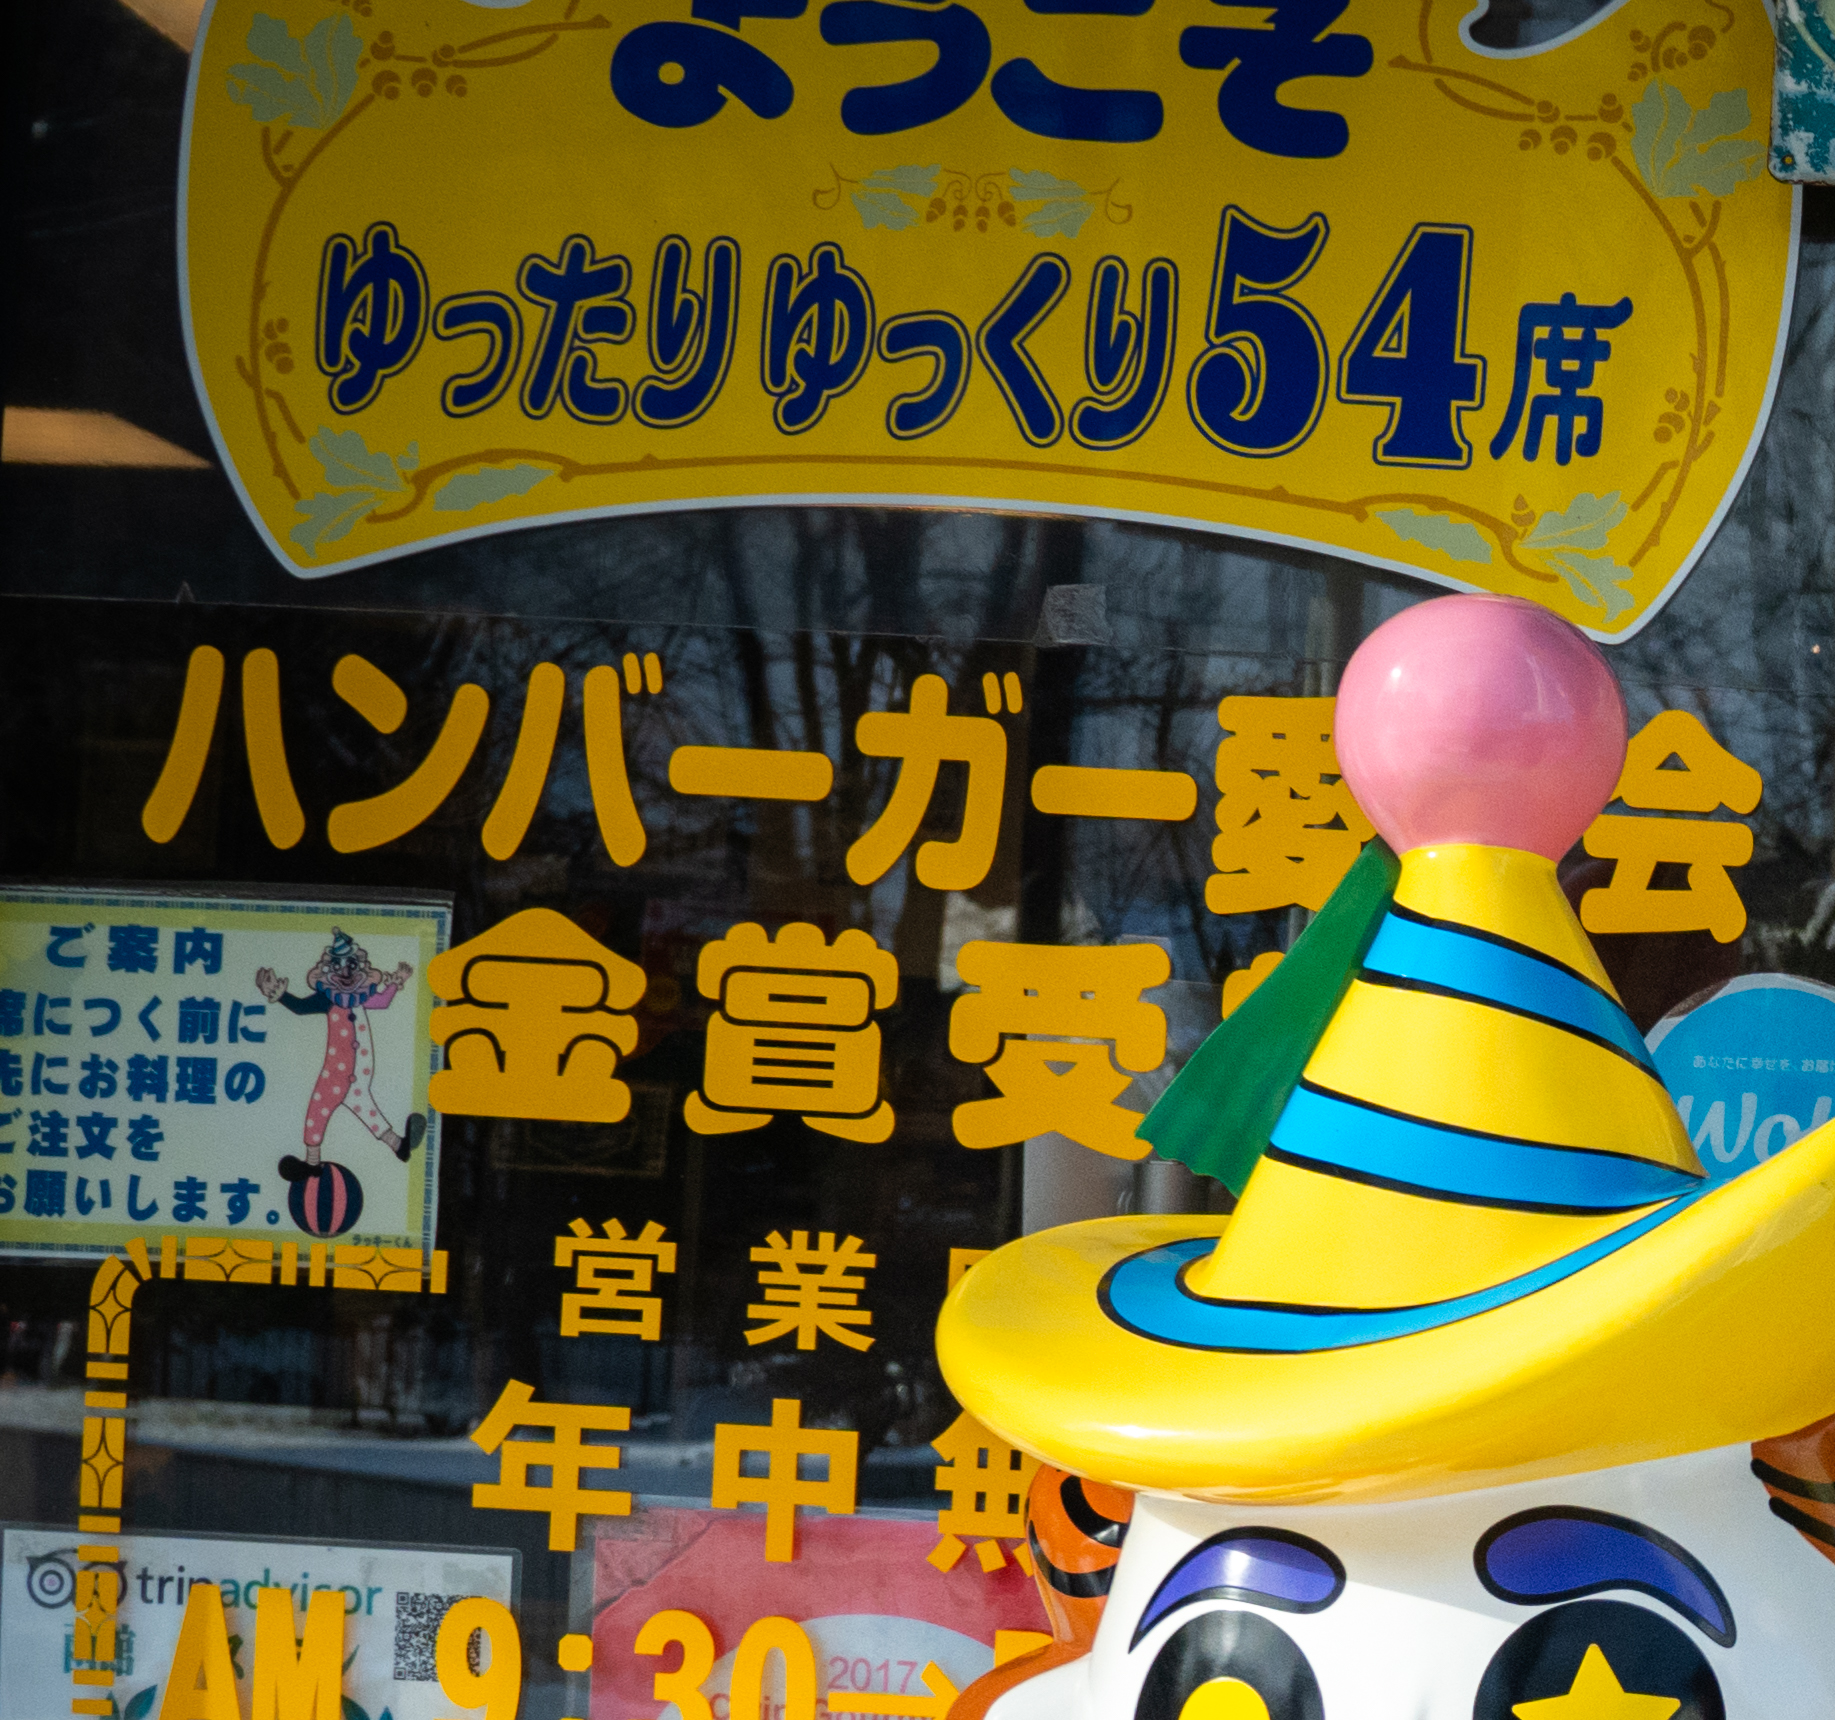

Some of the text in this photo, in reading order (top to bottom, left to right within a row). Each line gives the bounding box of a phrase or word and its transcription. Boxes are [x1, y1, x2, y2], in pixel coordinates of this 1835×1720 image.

[316, 203, 1634, 470] ゆったりゆっくり54席
[141, 642, 1765, 945] ハンバーガー愛会
[46, 924, 224, 974] ご案内
[426, 907, 1275, 1160] 金賞受
[553, 1217, 1003, 1352] 営業
[828, 1656, 917, 1693] 2017
